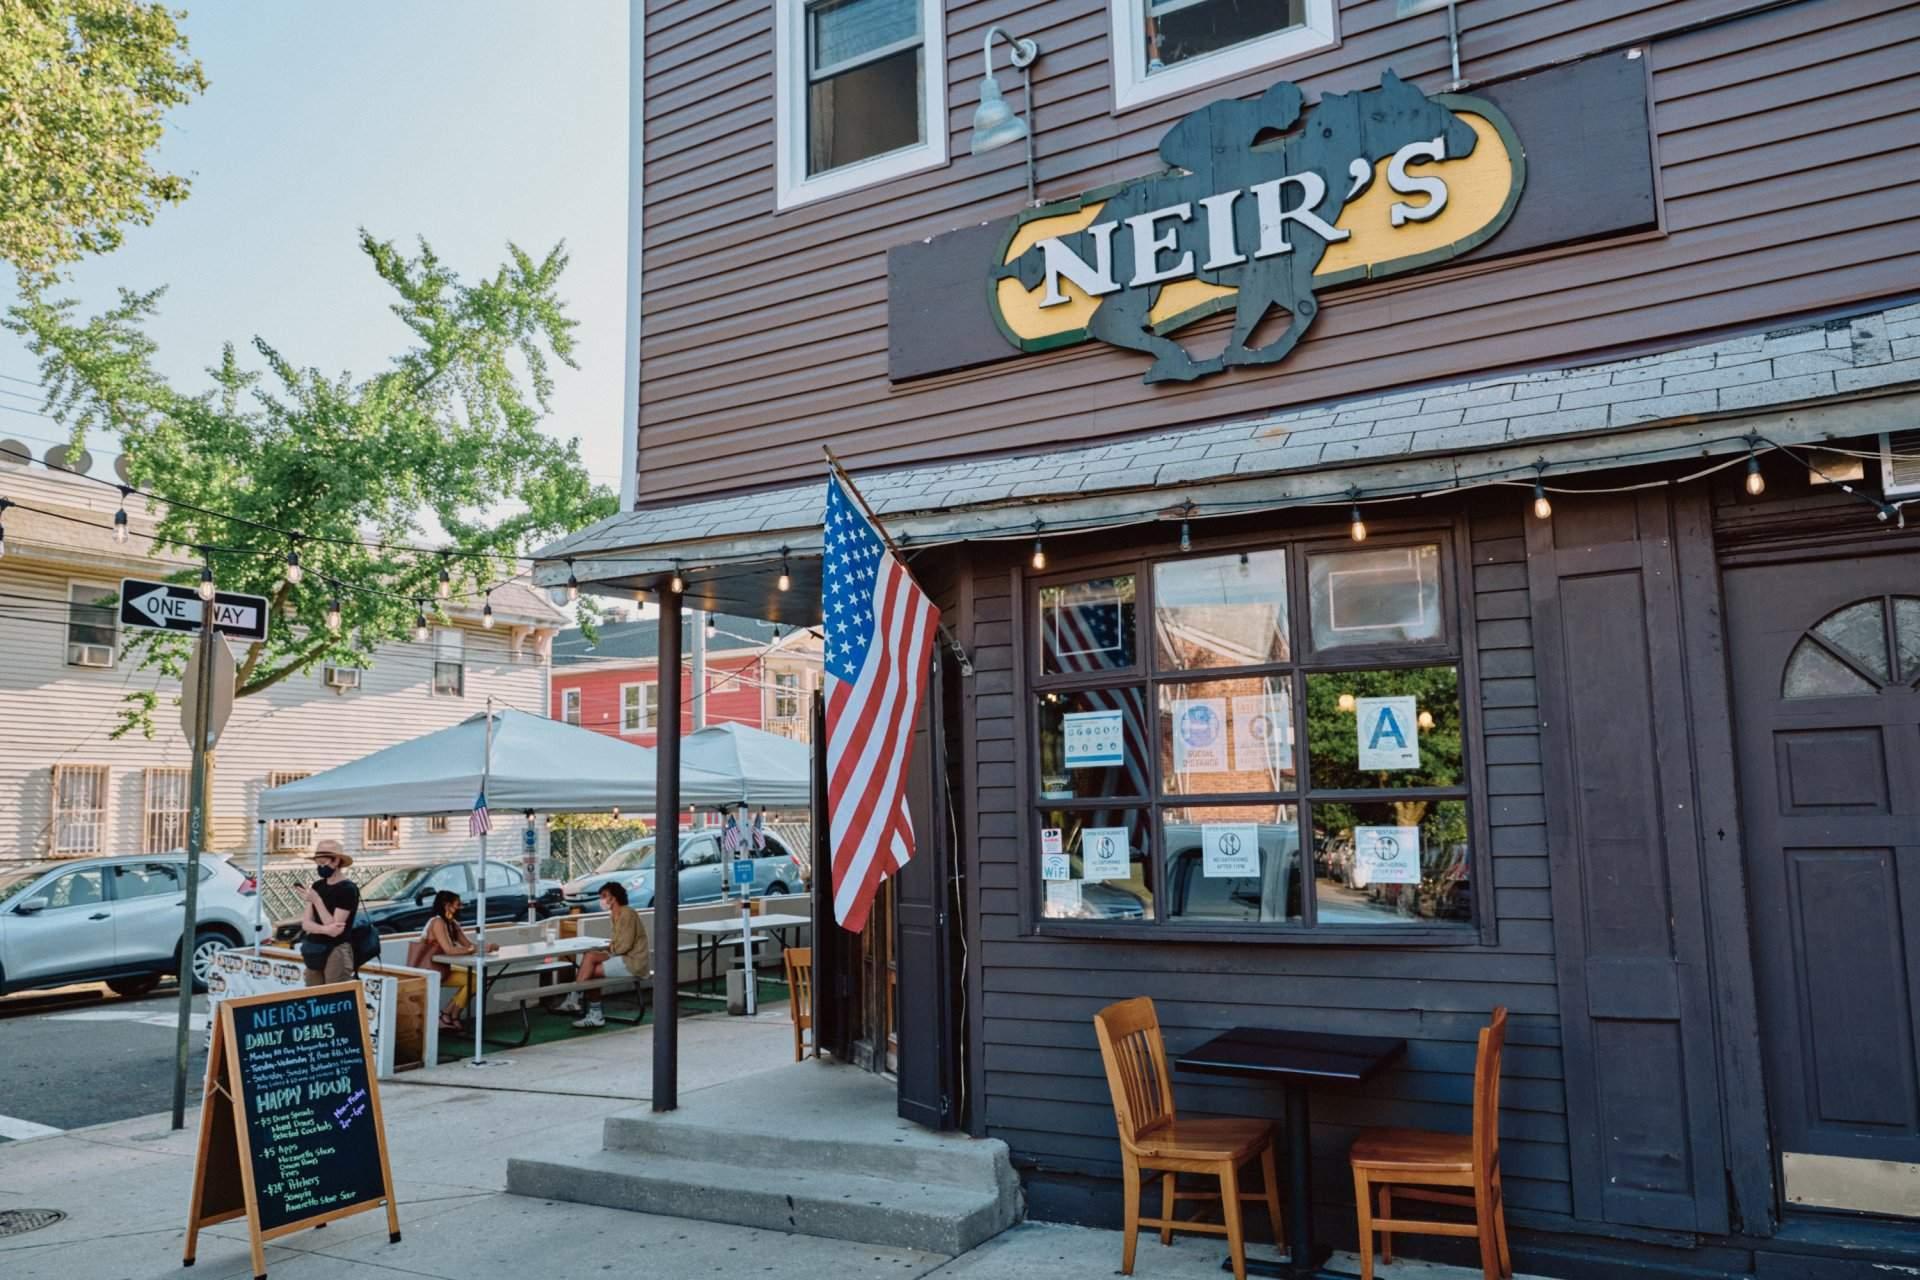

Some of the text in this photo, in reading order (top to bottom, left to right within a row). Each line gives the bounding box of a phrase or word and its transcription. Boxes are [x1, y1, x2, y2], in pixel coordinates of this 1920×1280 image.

[1037, 136, 1449, 309] NEIR'S
[146, 596, 187, 618] ONE
[1367, 706, 1409, 750] A
[253, 1002, 307, 1029] NEIR'S
[245, 1022, 335, 1050] DAILY DEALS
[256, 1076, 352, 1113] HAPPY HOUR
